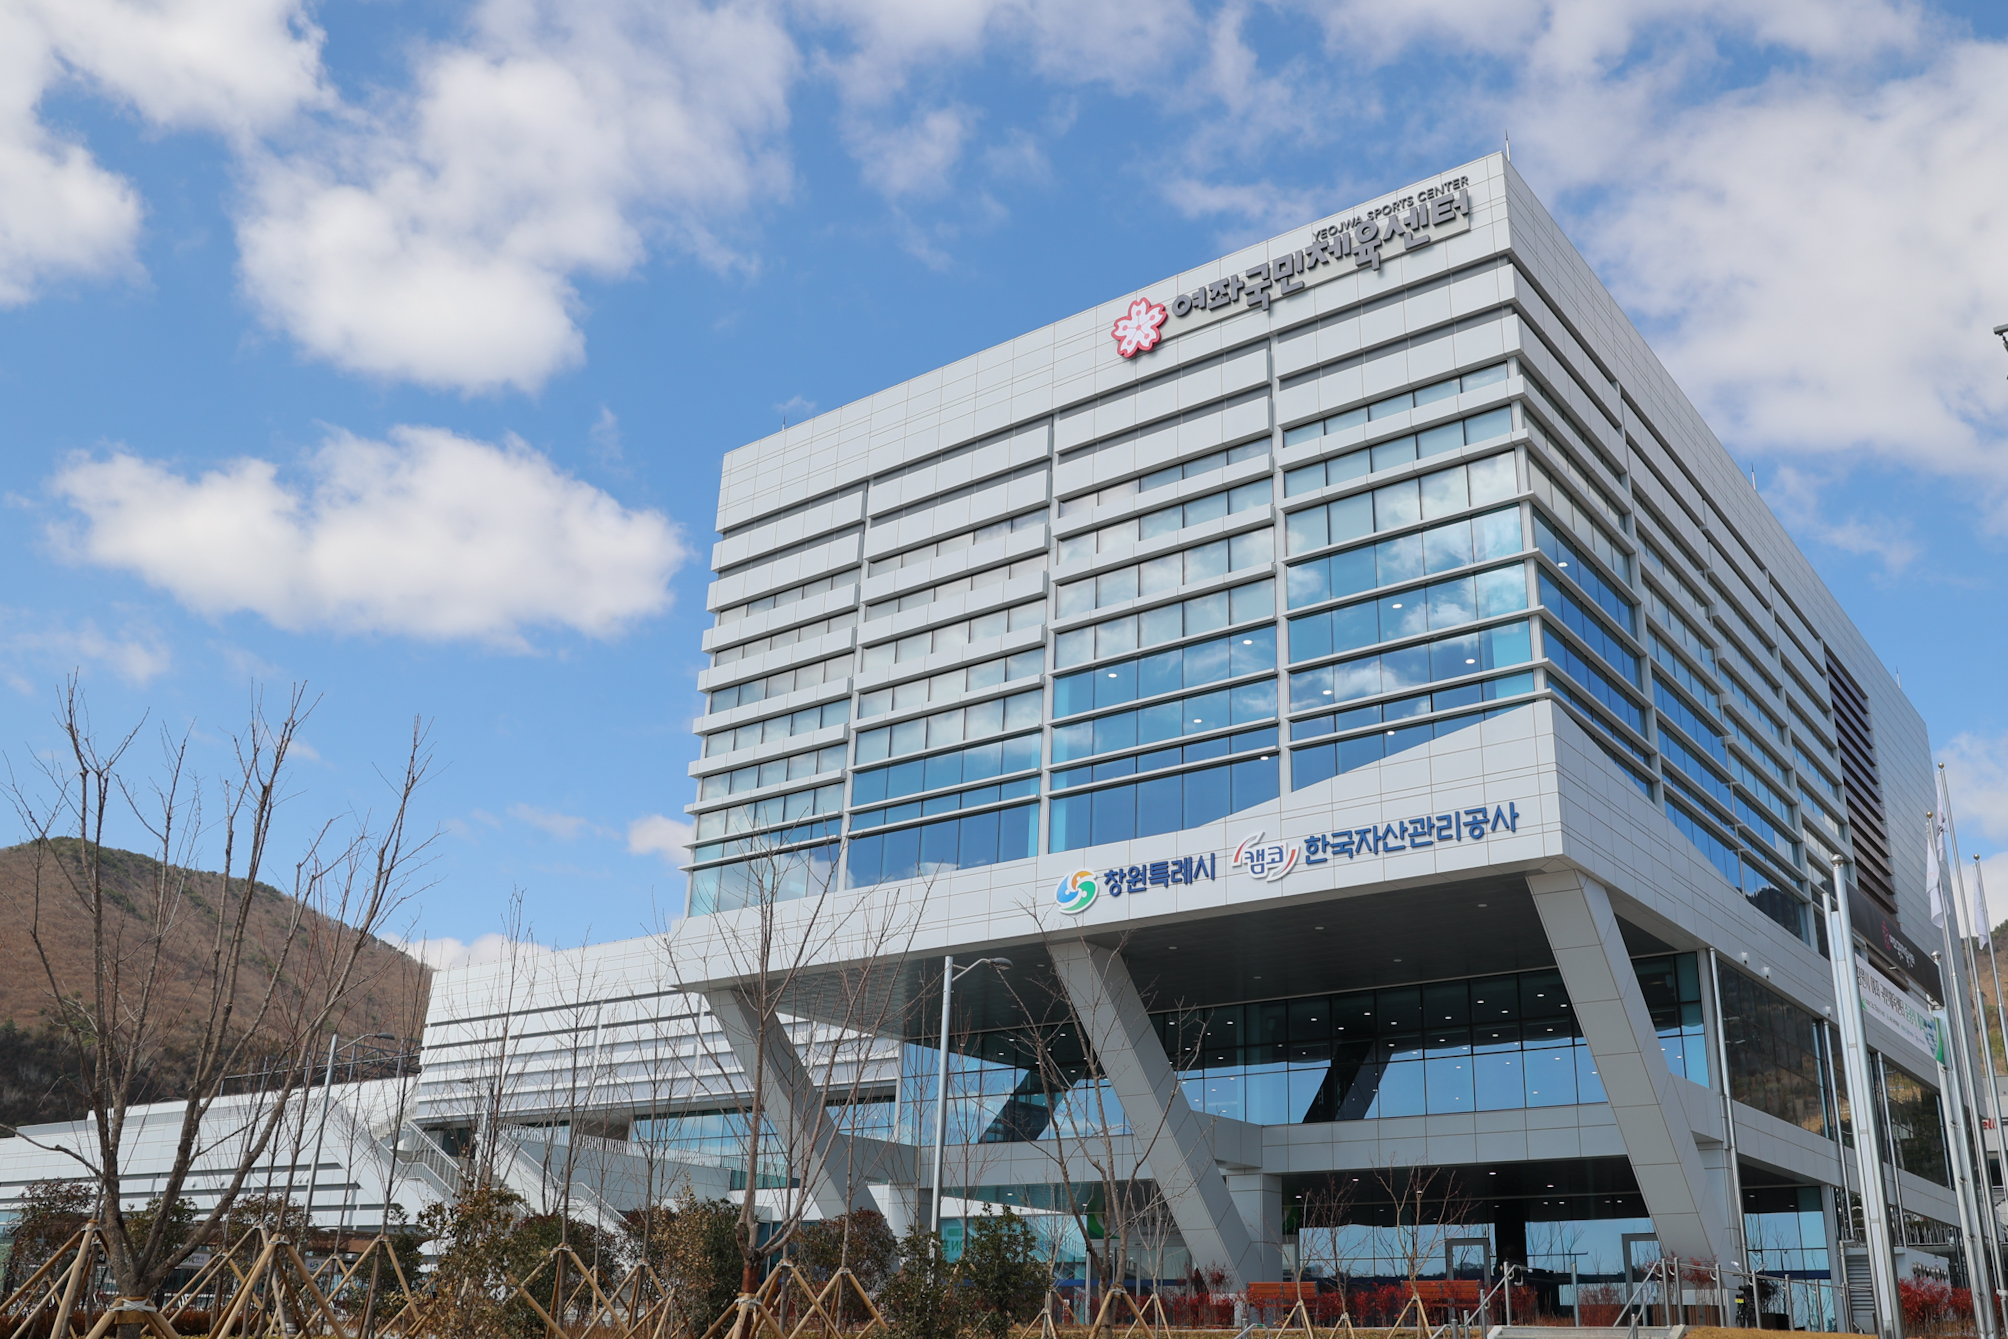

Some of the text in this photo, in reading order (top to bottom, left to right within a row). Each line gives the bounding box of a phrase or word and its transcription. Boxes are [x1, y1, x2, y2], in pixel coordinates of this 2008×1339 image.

[1312, 175, 1469, 241] YEOJWA SPORTS CENTER
[1171, 188, 1470, 317] 여좌국민체육센터
[1244, 846, 1284, 875] 캠코
[1304, 802, 1519, 865] 한국자산관리공사
[1104, 852, 1215, 897] 창원특례시
